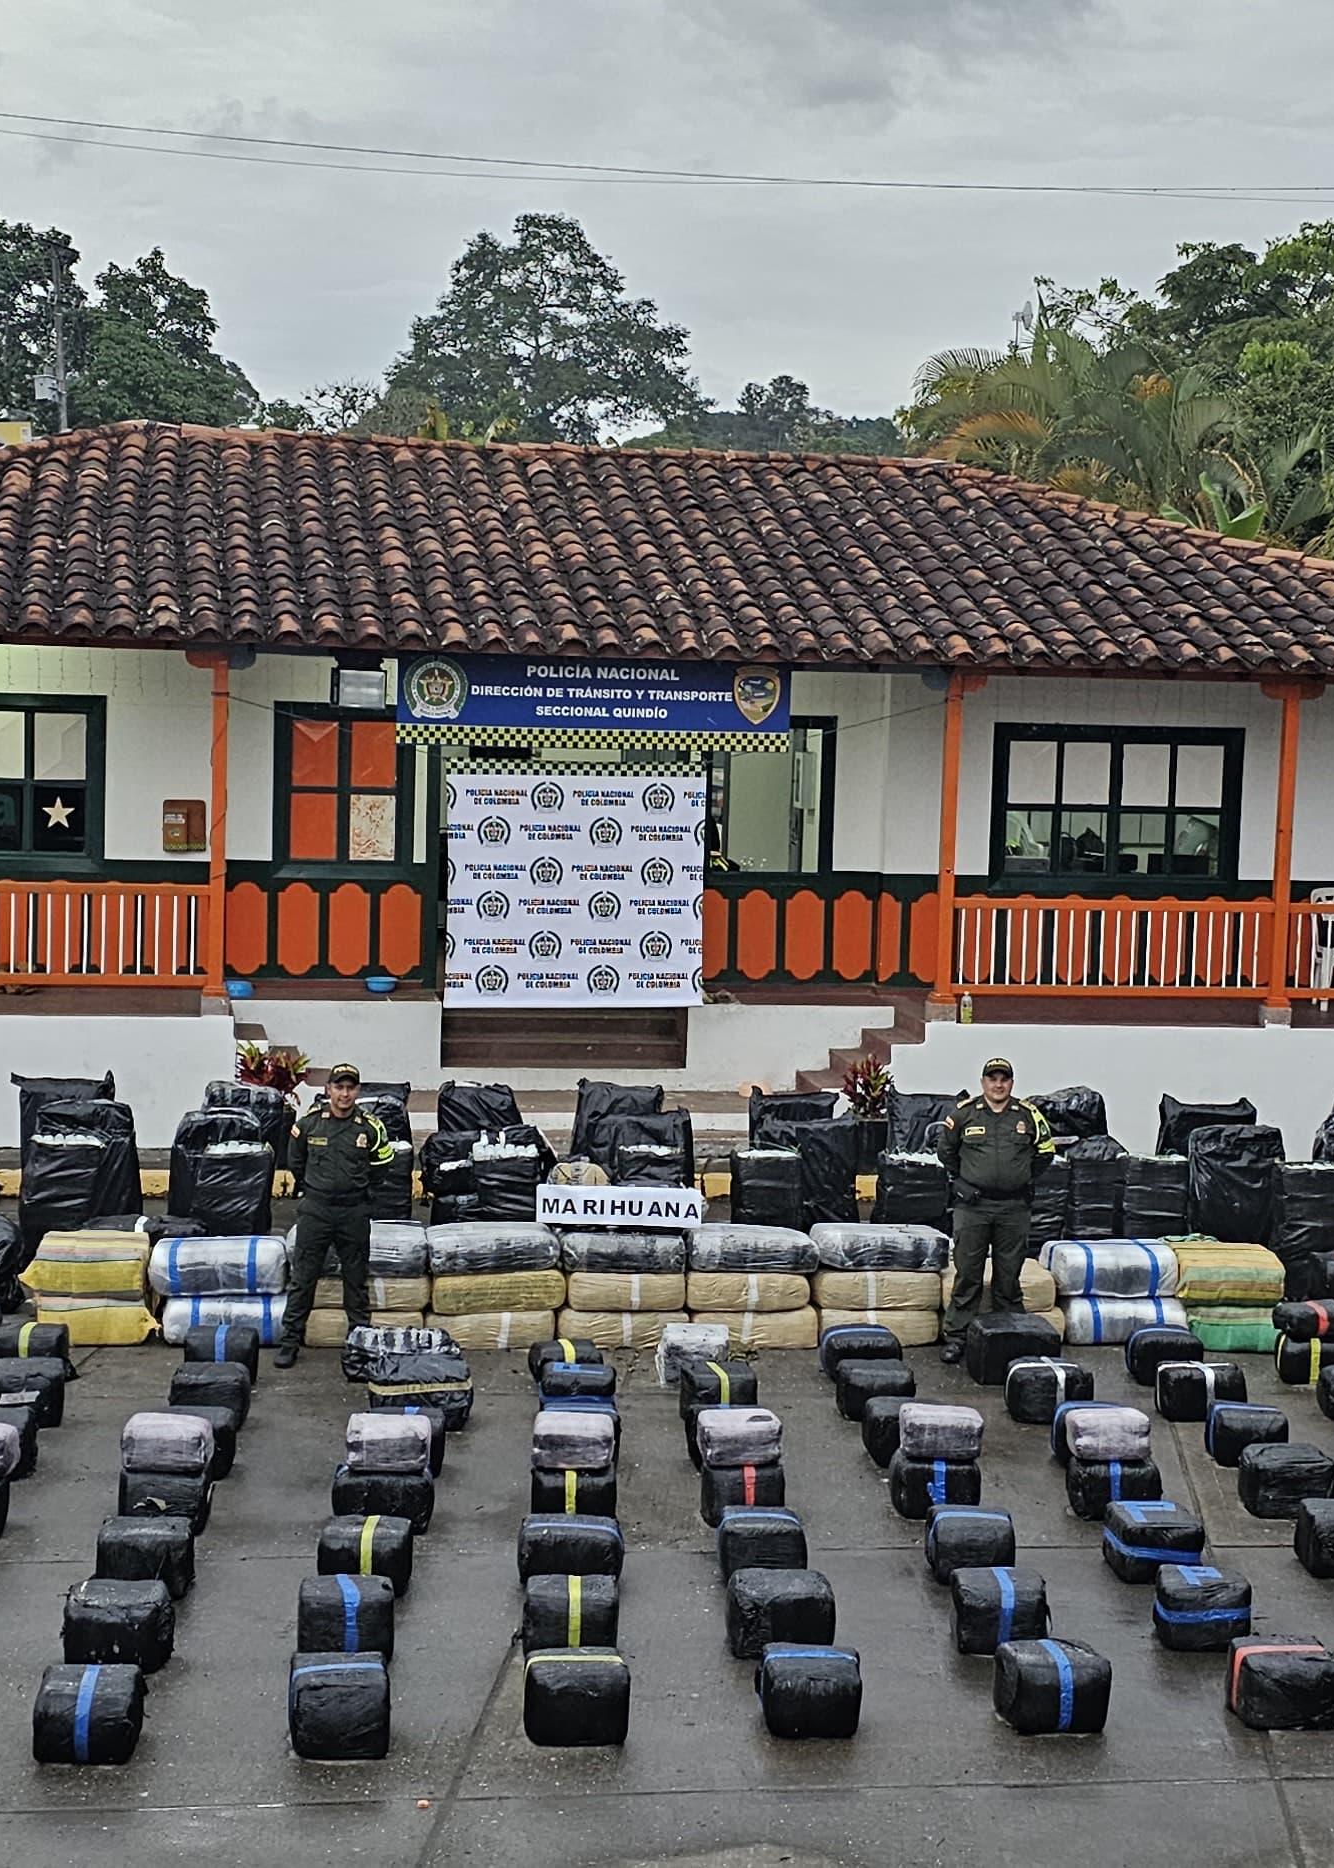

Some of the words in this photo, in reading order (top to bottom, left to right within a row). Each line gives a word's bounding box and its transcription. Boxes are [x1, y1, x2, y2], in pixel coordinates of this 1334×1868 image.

[526, 664, 592, 679] POLICÍA
[596, 667, 680, 681] NACIONAL
[471, 685, 543, 697] DIRECCIÓN
[546, 688, 564, 698] DE
[567, 687, 632, 699] TRÁNSITO
[635, 690, 644, 700] Y
[648, 690, 733, 702] TRANSPORTE
[535, 706, 609, 717] SECCIONAL
[613, 707, 668, 719] QUINDÍO
[545, 973, 578, 982] NACIONAL
[656, 973, 688, 982] NACIONAL
[542, 1198, 699, 1219] MARIHUANA
